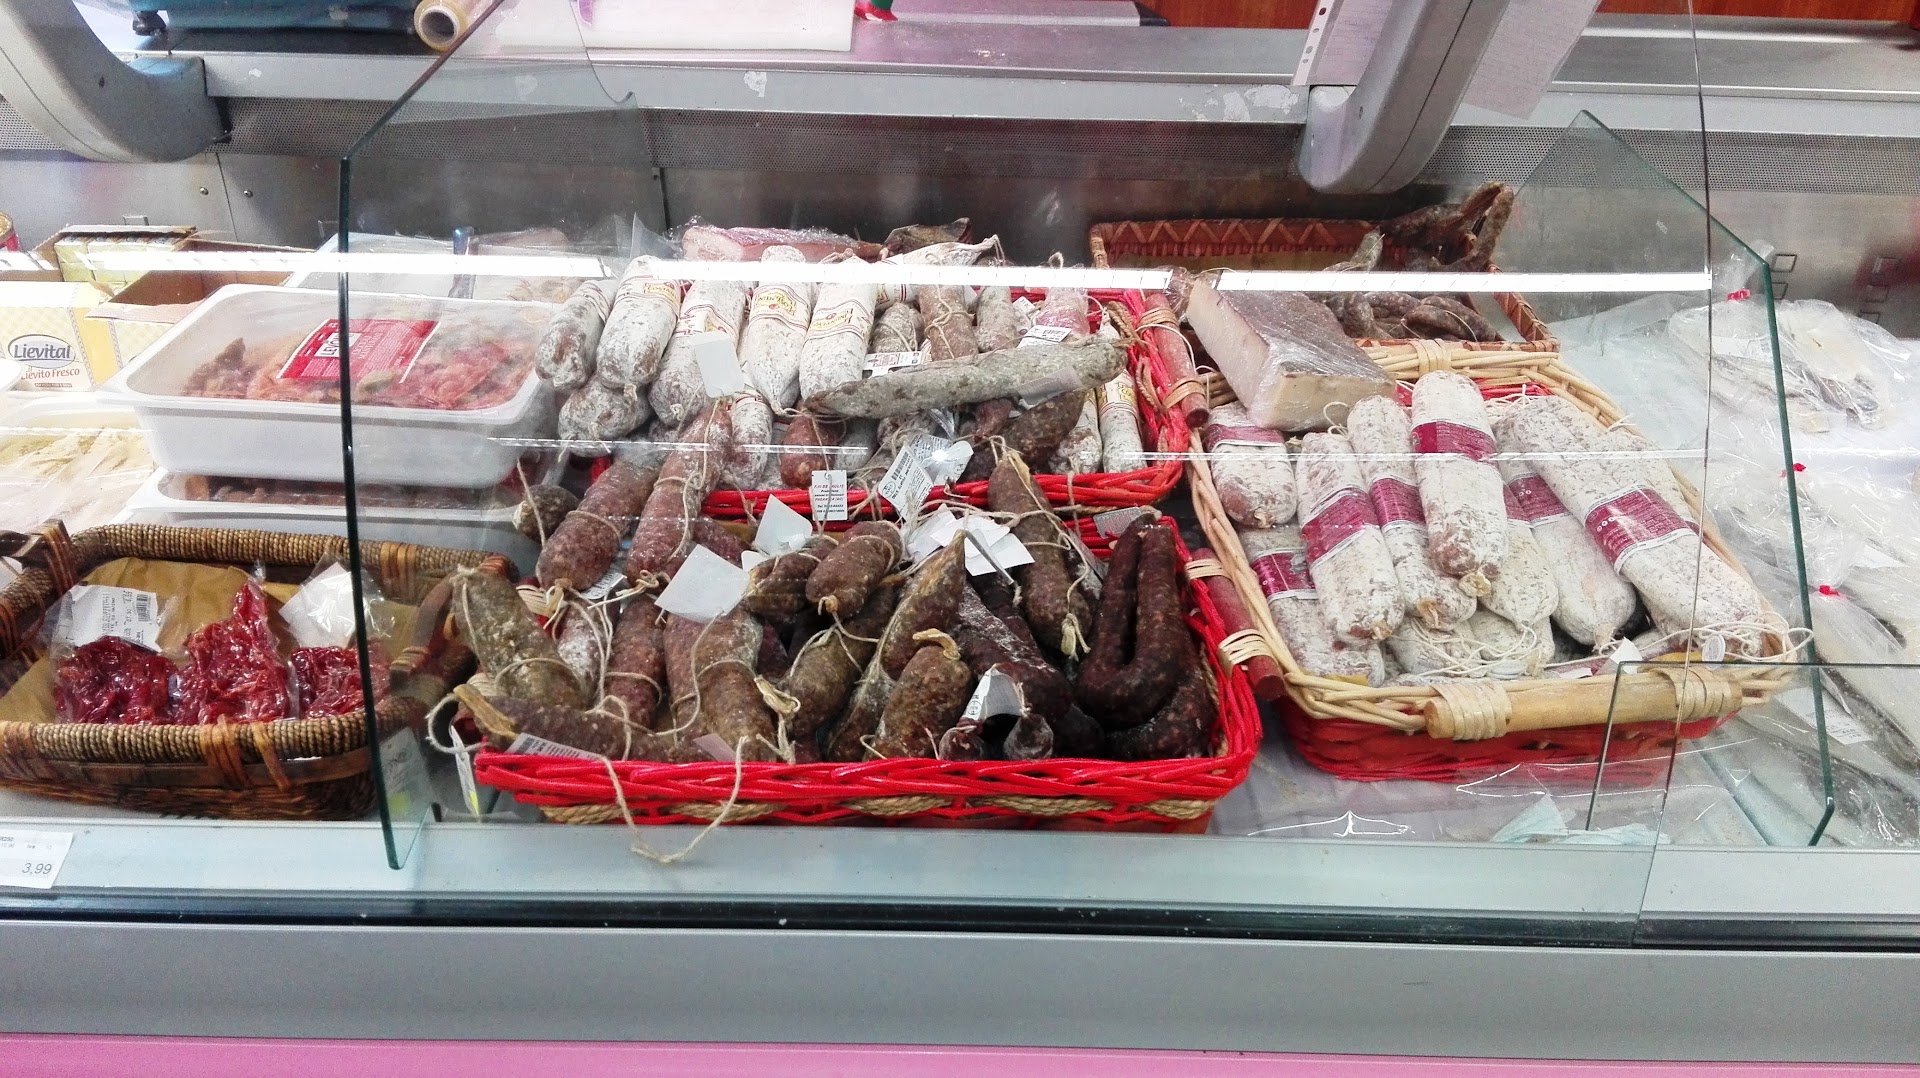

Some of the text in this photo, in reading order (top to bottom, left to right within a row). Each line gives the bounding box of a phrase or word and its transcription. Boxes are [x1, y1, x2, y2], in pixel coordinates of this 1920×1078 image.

[14, 344, 71, 359] Lievital
[52, 368, 80, 378] Fresco
[22, 862, 52, 875] 3,99
